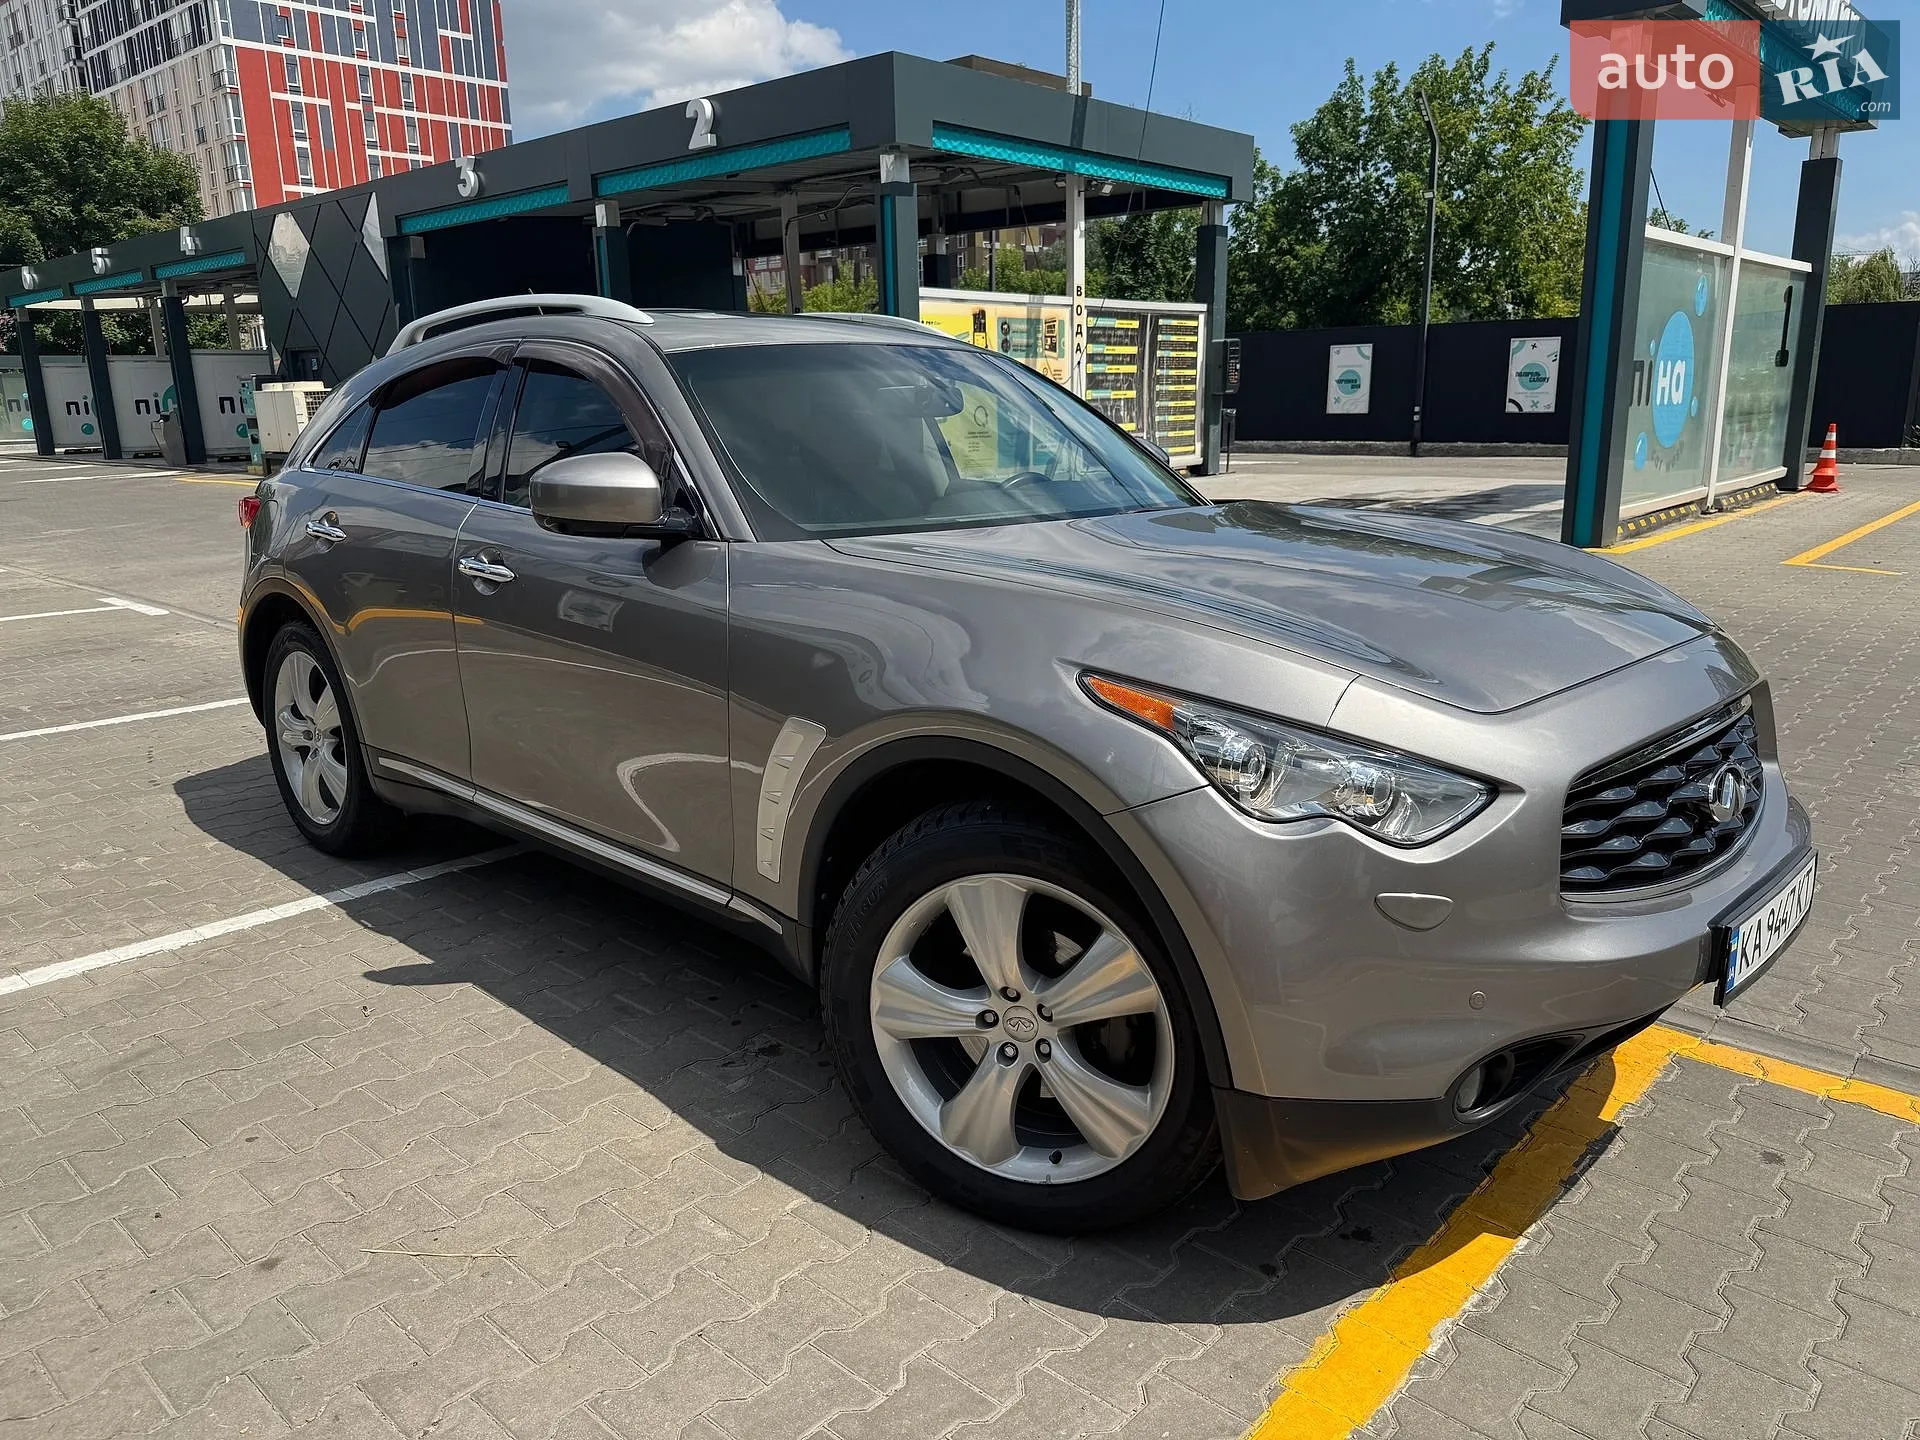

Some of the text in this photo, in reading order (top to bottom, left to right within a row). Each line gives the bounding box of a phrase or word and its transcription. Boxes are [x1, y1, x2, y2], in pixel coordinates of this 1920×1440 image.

[686, 98, 717, 150] 2
[455, 155, 479, 198] 3
[91, 247, 107, 275] 5
[180, 226, 197, 256] 4
[1075, 285, 1084, 354] ВОДА
[1738, 918, 1762, 975] KA
[1766, 889, 1796, 952] 9447
